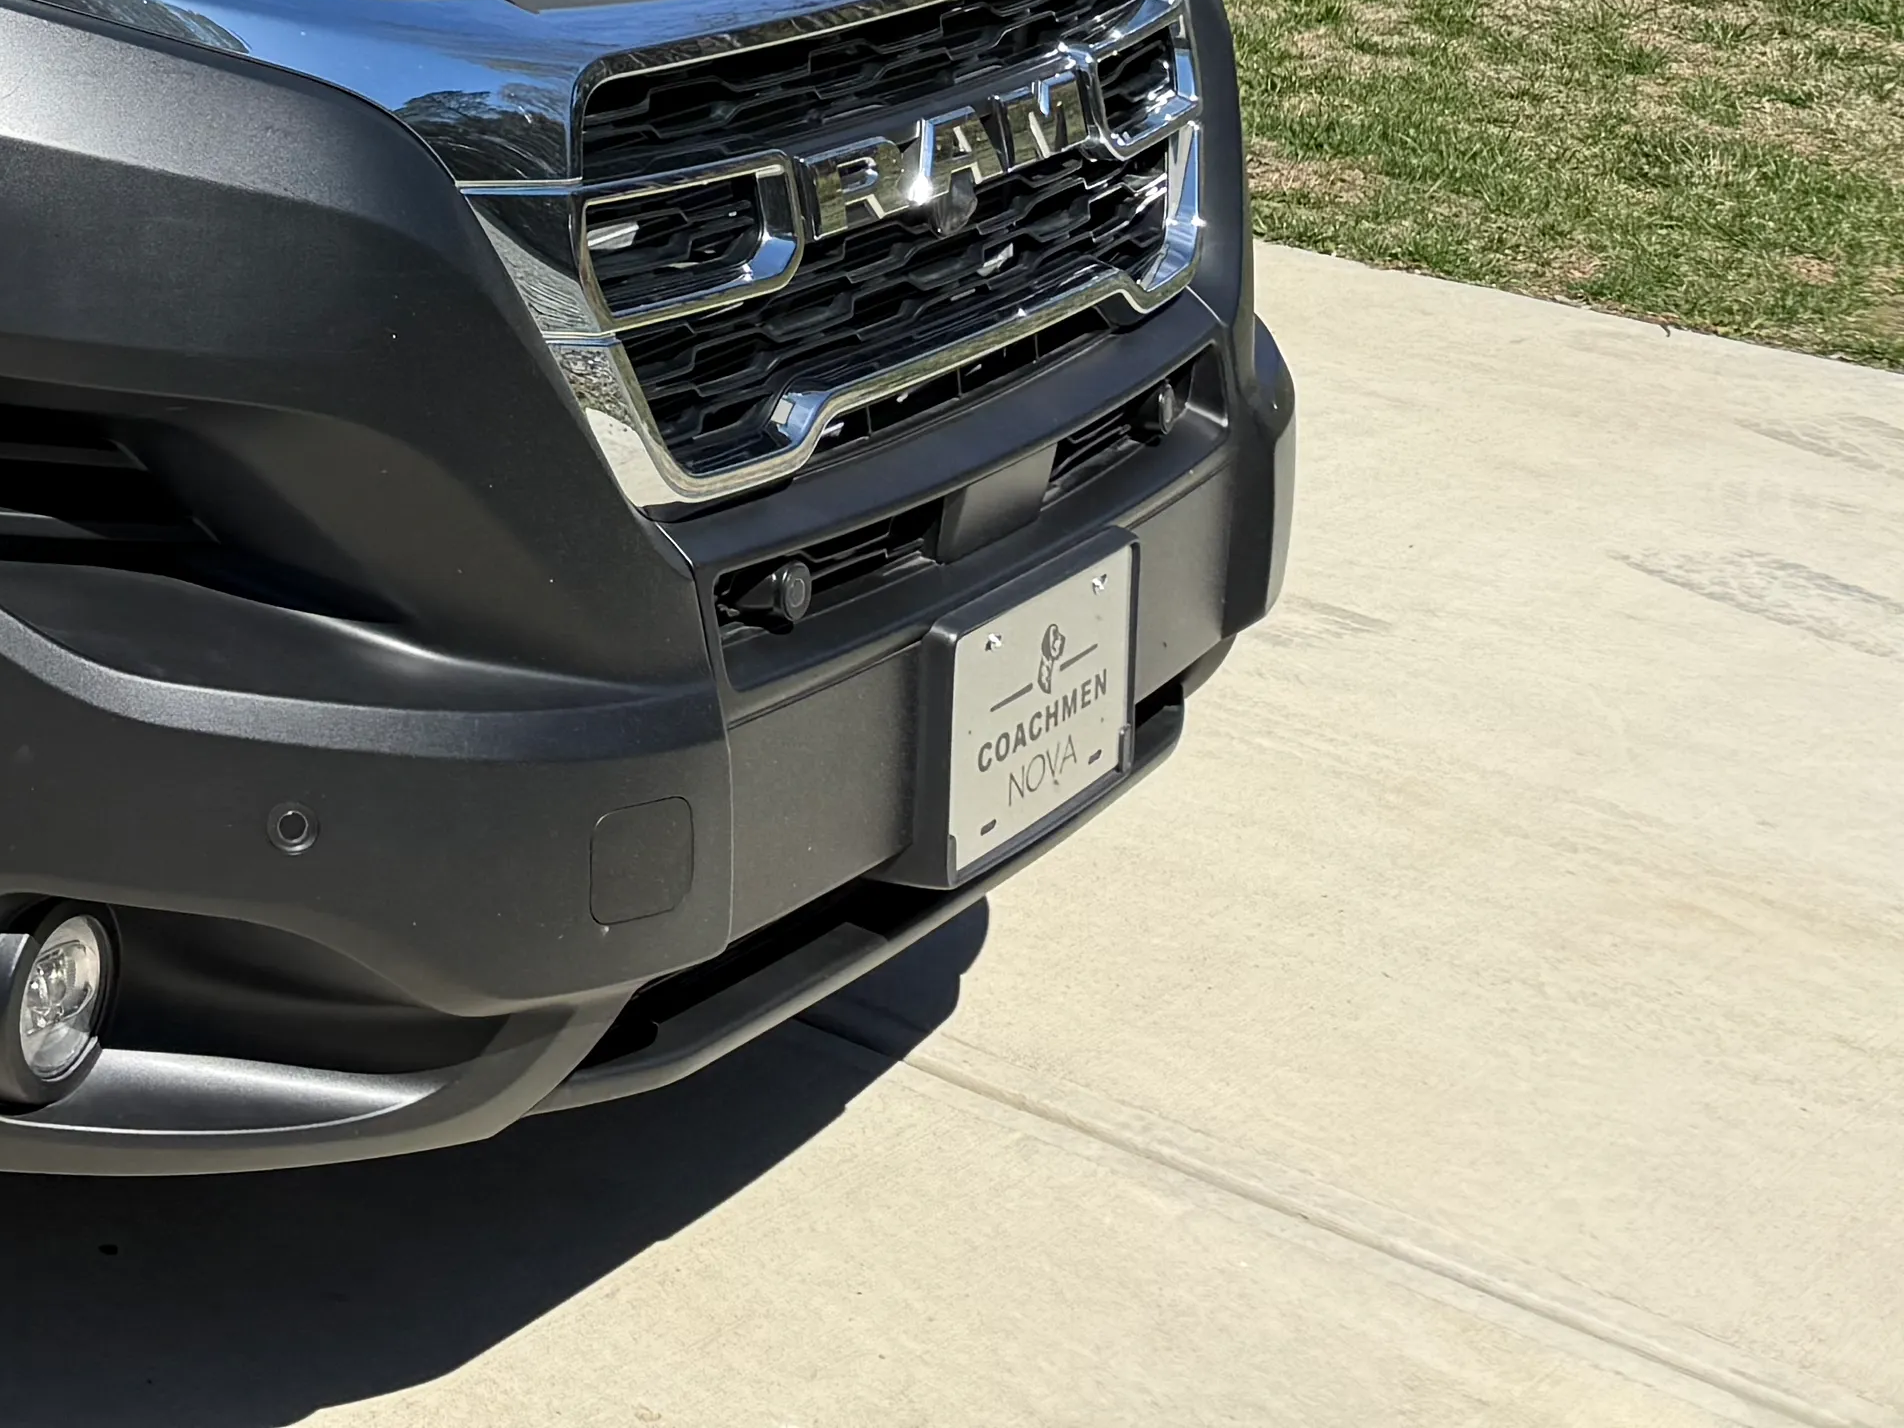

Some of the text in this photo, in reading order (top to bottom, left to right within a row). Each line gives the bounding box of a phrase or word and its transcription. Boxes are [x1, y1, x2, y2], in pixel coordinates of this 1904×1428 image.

[798, 72, 1089, 239] RAM
[978, 669, 1108, 772] COACHMEN
[1008, 734, 1077, 806] NOVA
